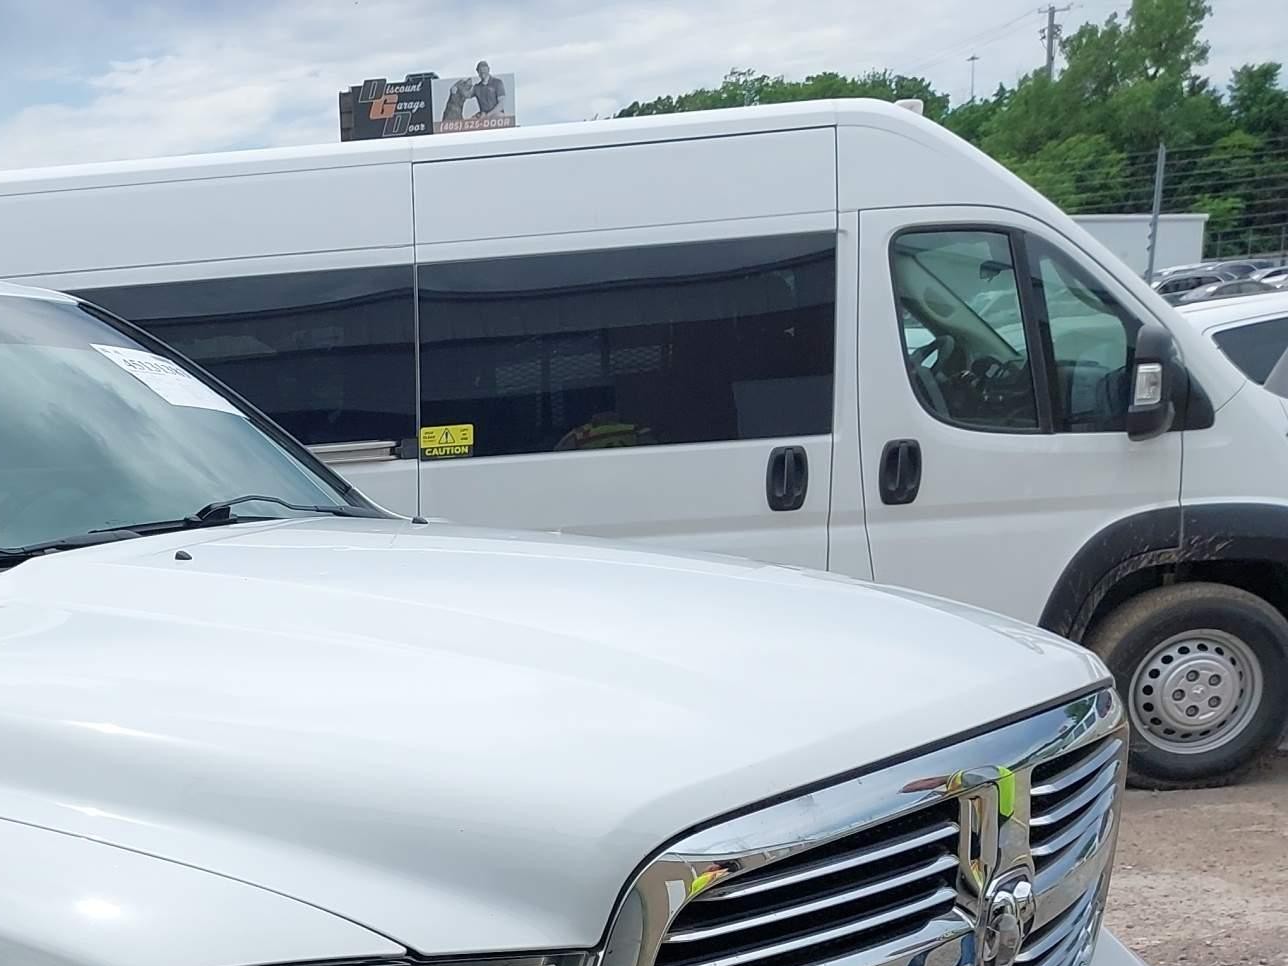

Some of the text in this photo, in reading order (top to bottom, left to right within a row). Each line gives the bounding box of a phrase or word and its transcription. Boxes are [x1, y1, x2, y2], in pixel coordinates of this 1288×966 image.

[358, 79, 423, 103] Discount
[369, 94, 425, 120] Garage
[382, 112, 426, 137] Door
[425, 447, 469, 456] CAUTION
